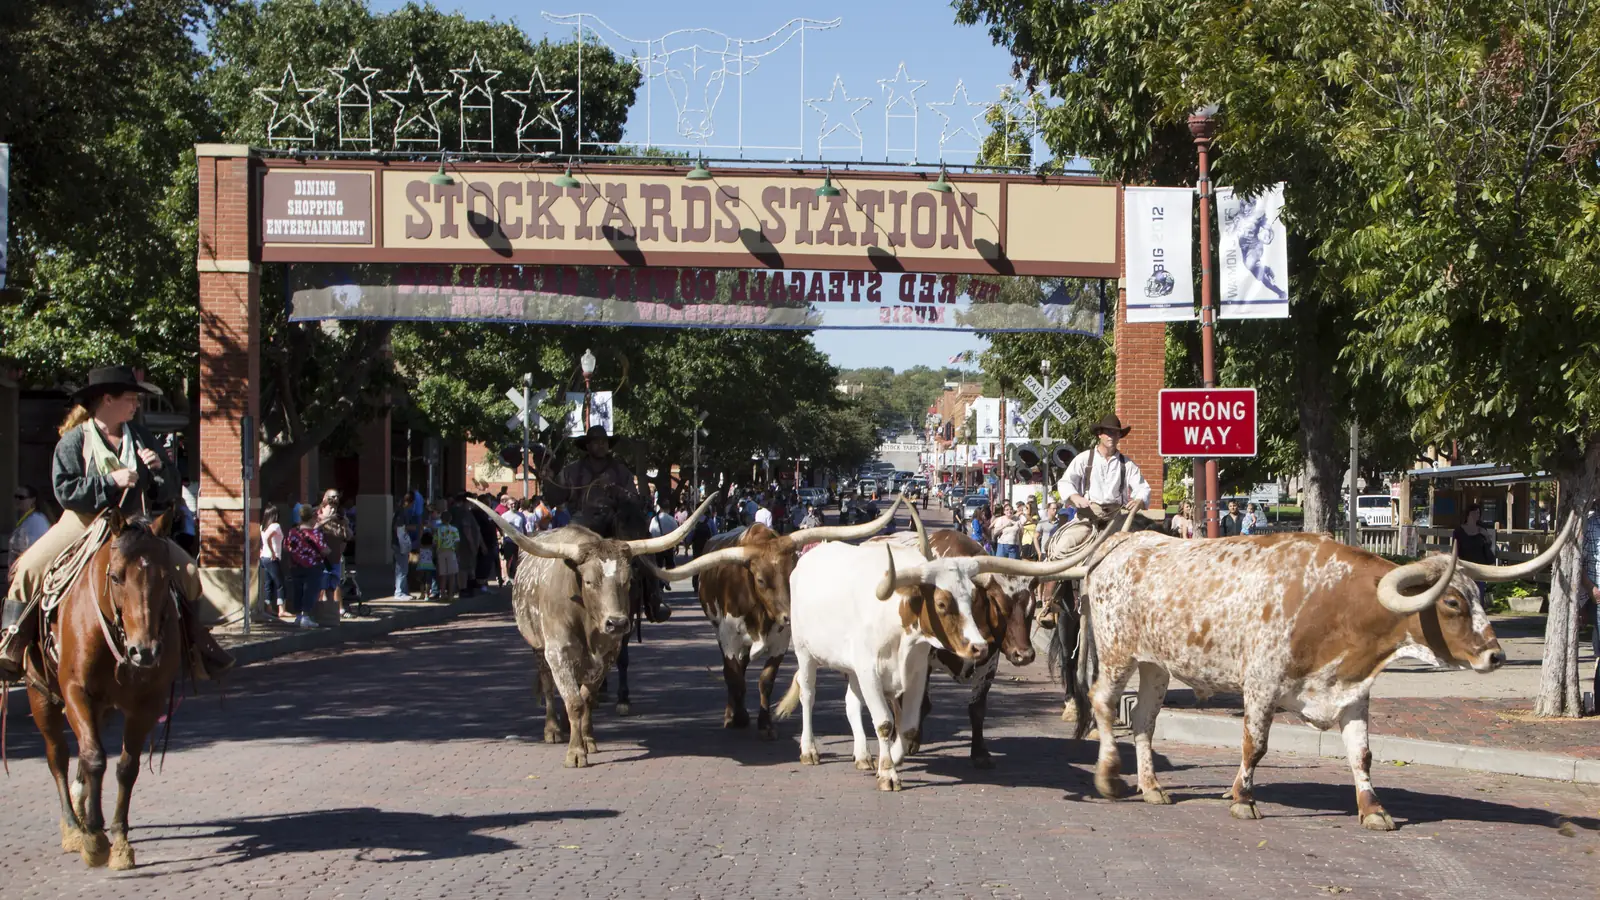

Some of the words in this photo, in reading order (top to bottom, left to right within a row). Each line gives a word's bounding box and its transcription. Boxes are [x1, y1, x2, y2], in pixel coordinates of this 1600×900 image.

[294, 180, 336, 197] DINING
[287, 199, 344, 216] SHOPPING
[405, 180, 740, 243] STOCKYARDS
[761, 185, 978, 250] STATION
[266, 219, 366, 236] ENTERTAINMENT
[1152, 248, 1164, 272] BIG
[1225, 249, 1238, 298] WAYMON
[1026, 378, 1043, 397] RAIL
[1051, 403, 1068, 422] ROAD
[1027, 379, 1067, 419] CROSSING
[1170, 401, 1246, 421] WRONG
[1183, 426, 1232, 445] WAY
